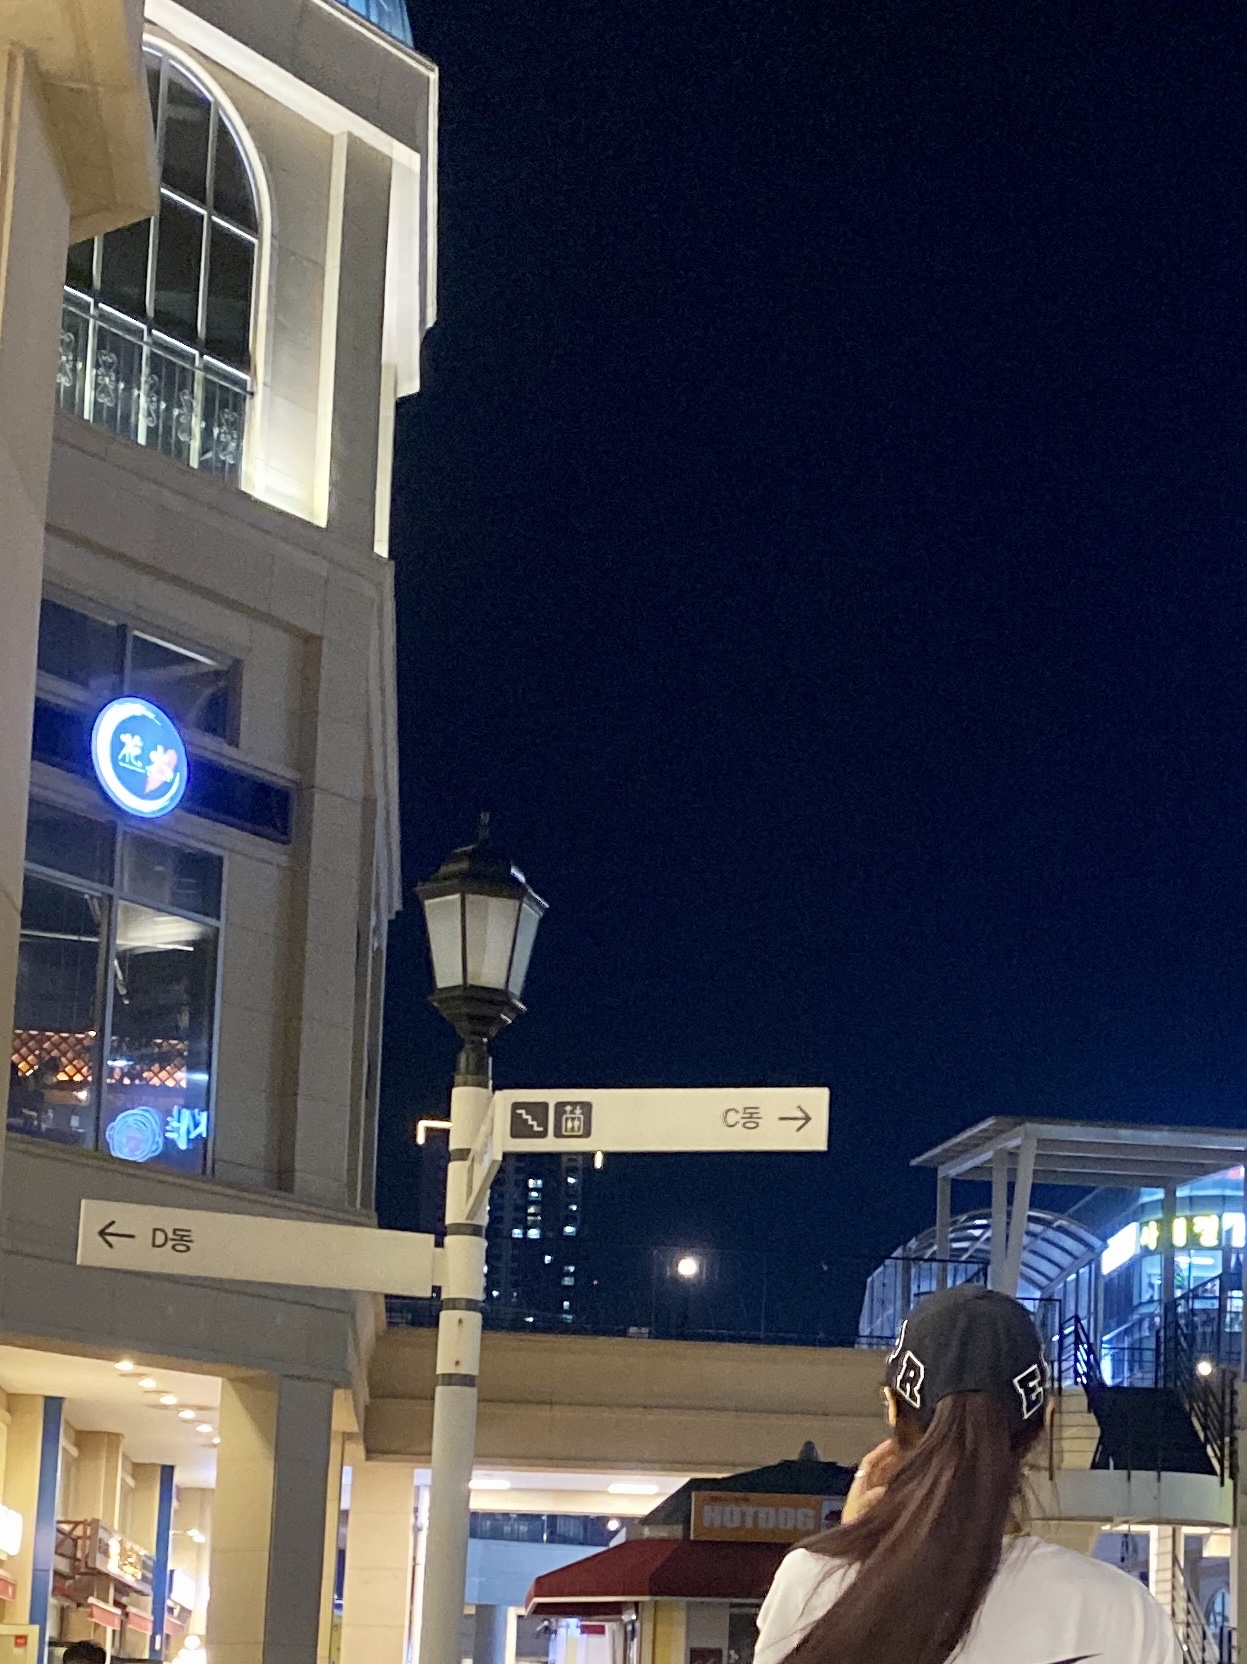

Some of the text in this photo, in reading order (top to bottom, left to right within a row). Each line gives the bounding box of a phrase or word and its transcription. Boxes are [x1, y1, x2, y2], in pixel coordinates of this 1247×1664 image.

[722, 1106, 763, 1130] C동
[151, 1227, 194, 1253] D동
[703, 1504, 815, 1531] HOTDOG
